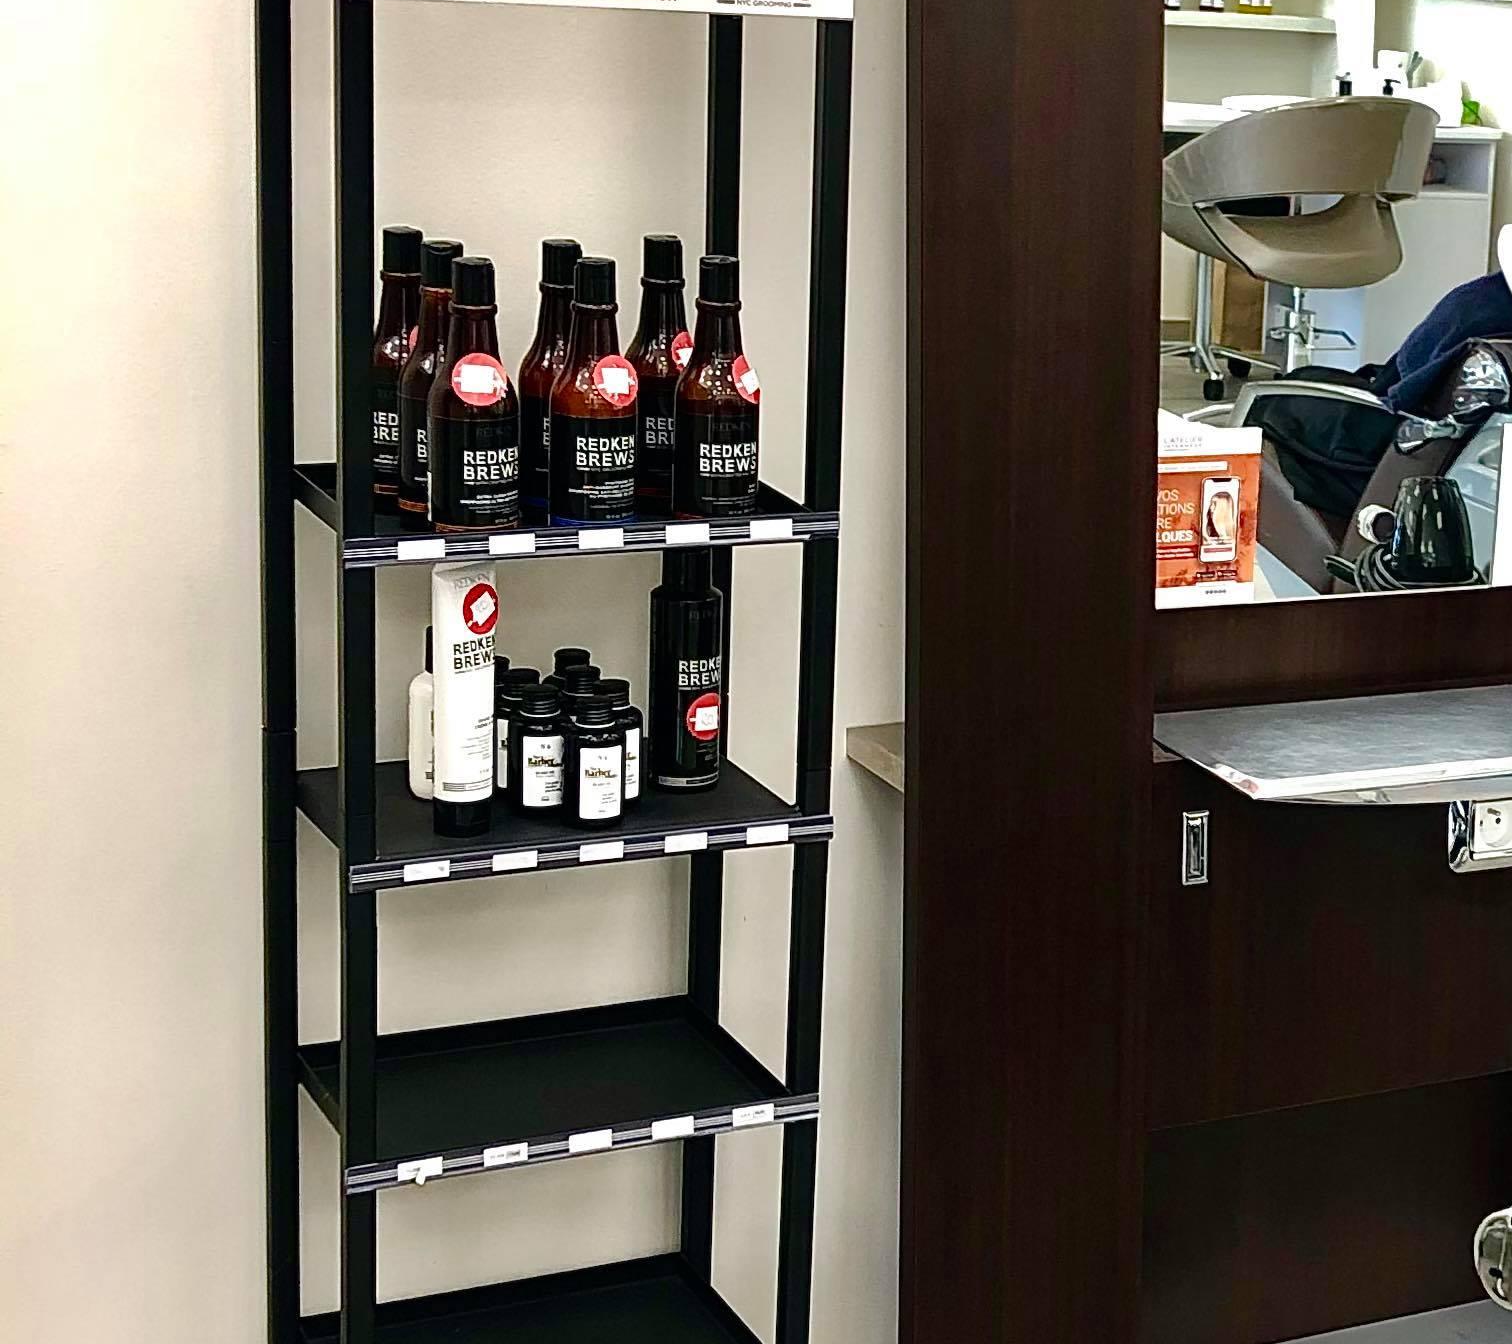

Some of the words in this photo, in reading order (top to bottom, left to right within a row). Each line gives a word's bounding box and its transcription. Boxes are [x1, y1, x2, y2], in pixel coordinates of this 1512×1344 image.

[576, 435, 635, 452] REDKEN
[700, 441, 757, 458] REDKEN
[575, 449, 635, 467] BREWS
[700, 456, 756, 473] BREWS
